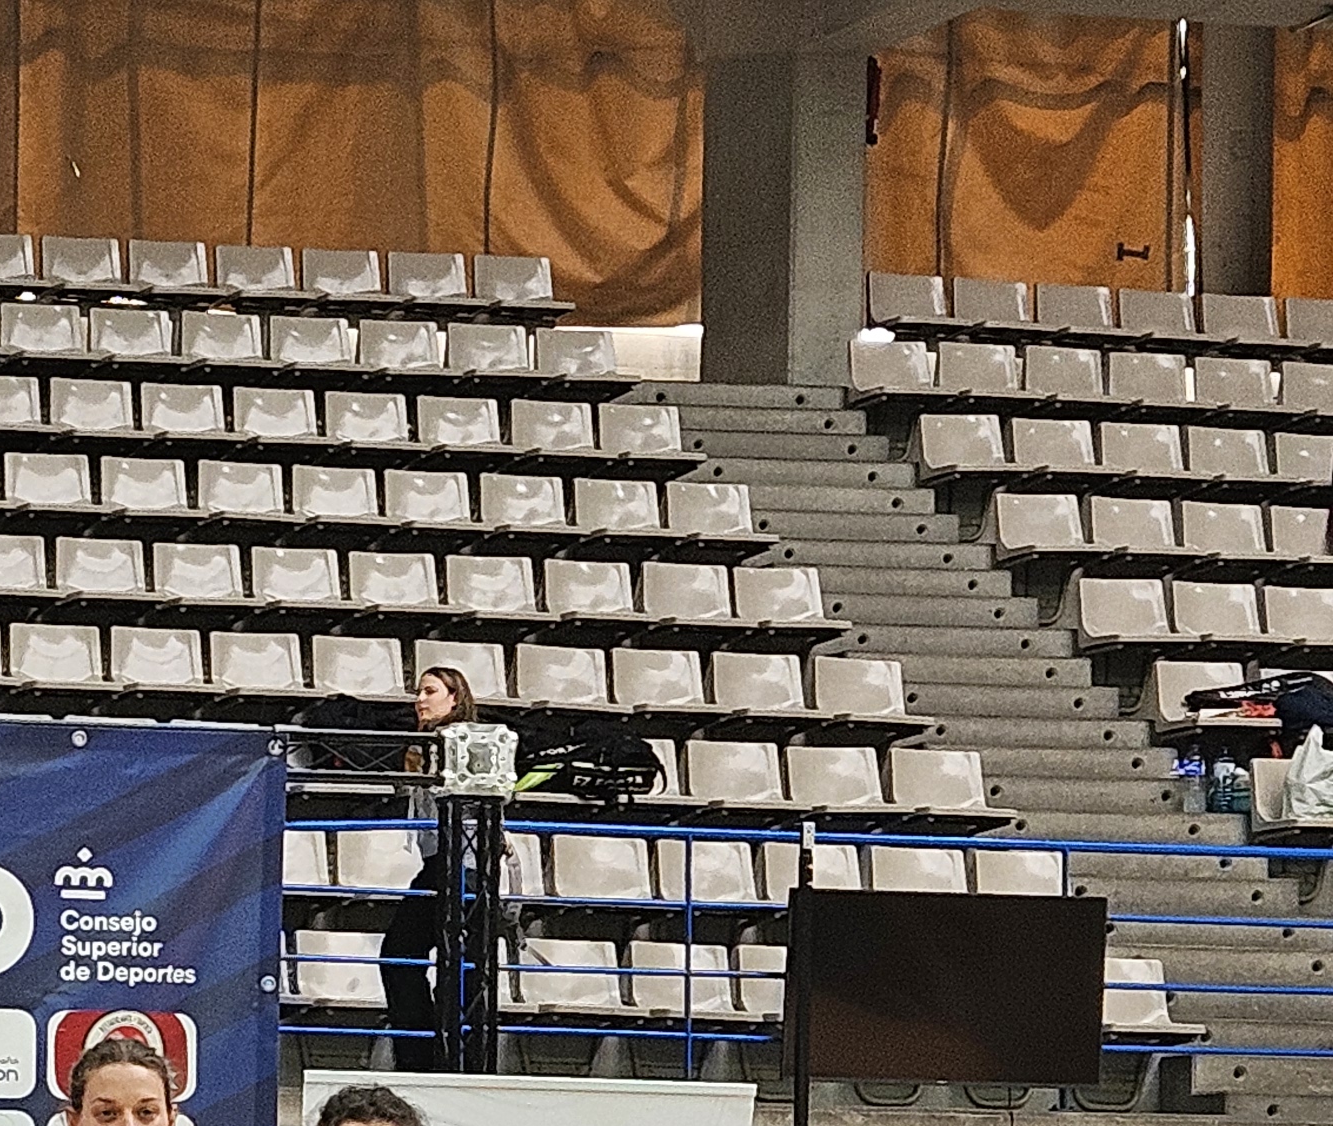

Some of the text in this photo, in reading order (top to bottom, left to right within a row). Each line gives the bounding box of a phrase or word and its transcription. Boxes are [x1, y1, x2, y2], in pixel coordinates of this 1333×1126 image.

[60, 909, 158, 935] Consejo
[60, 935, 164, 963] Superior
[60, 962, 197, 989] de Deportes
